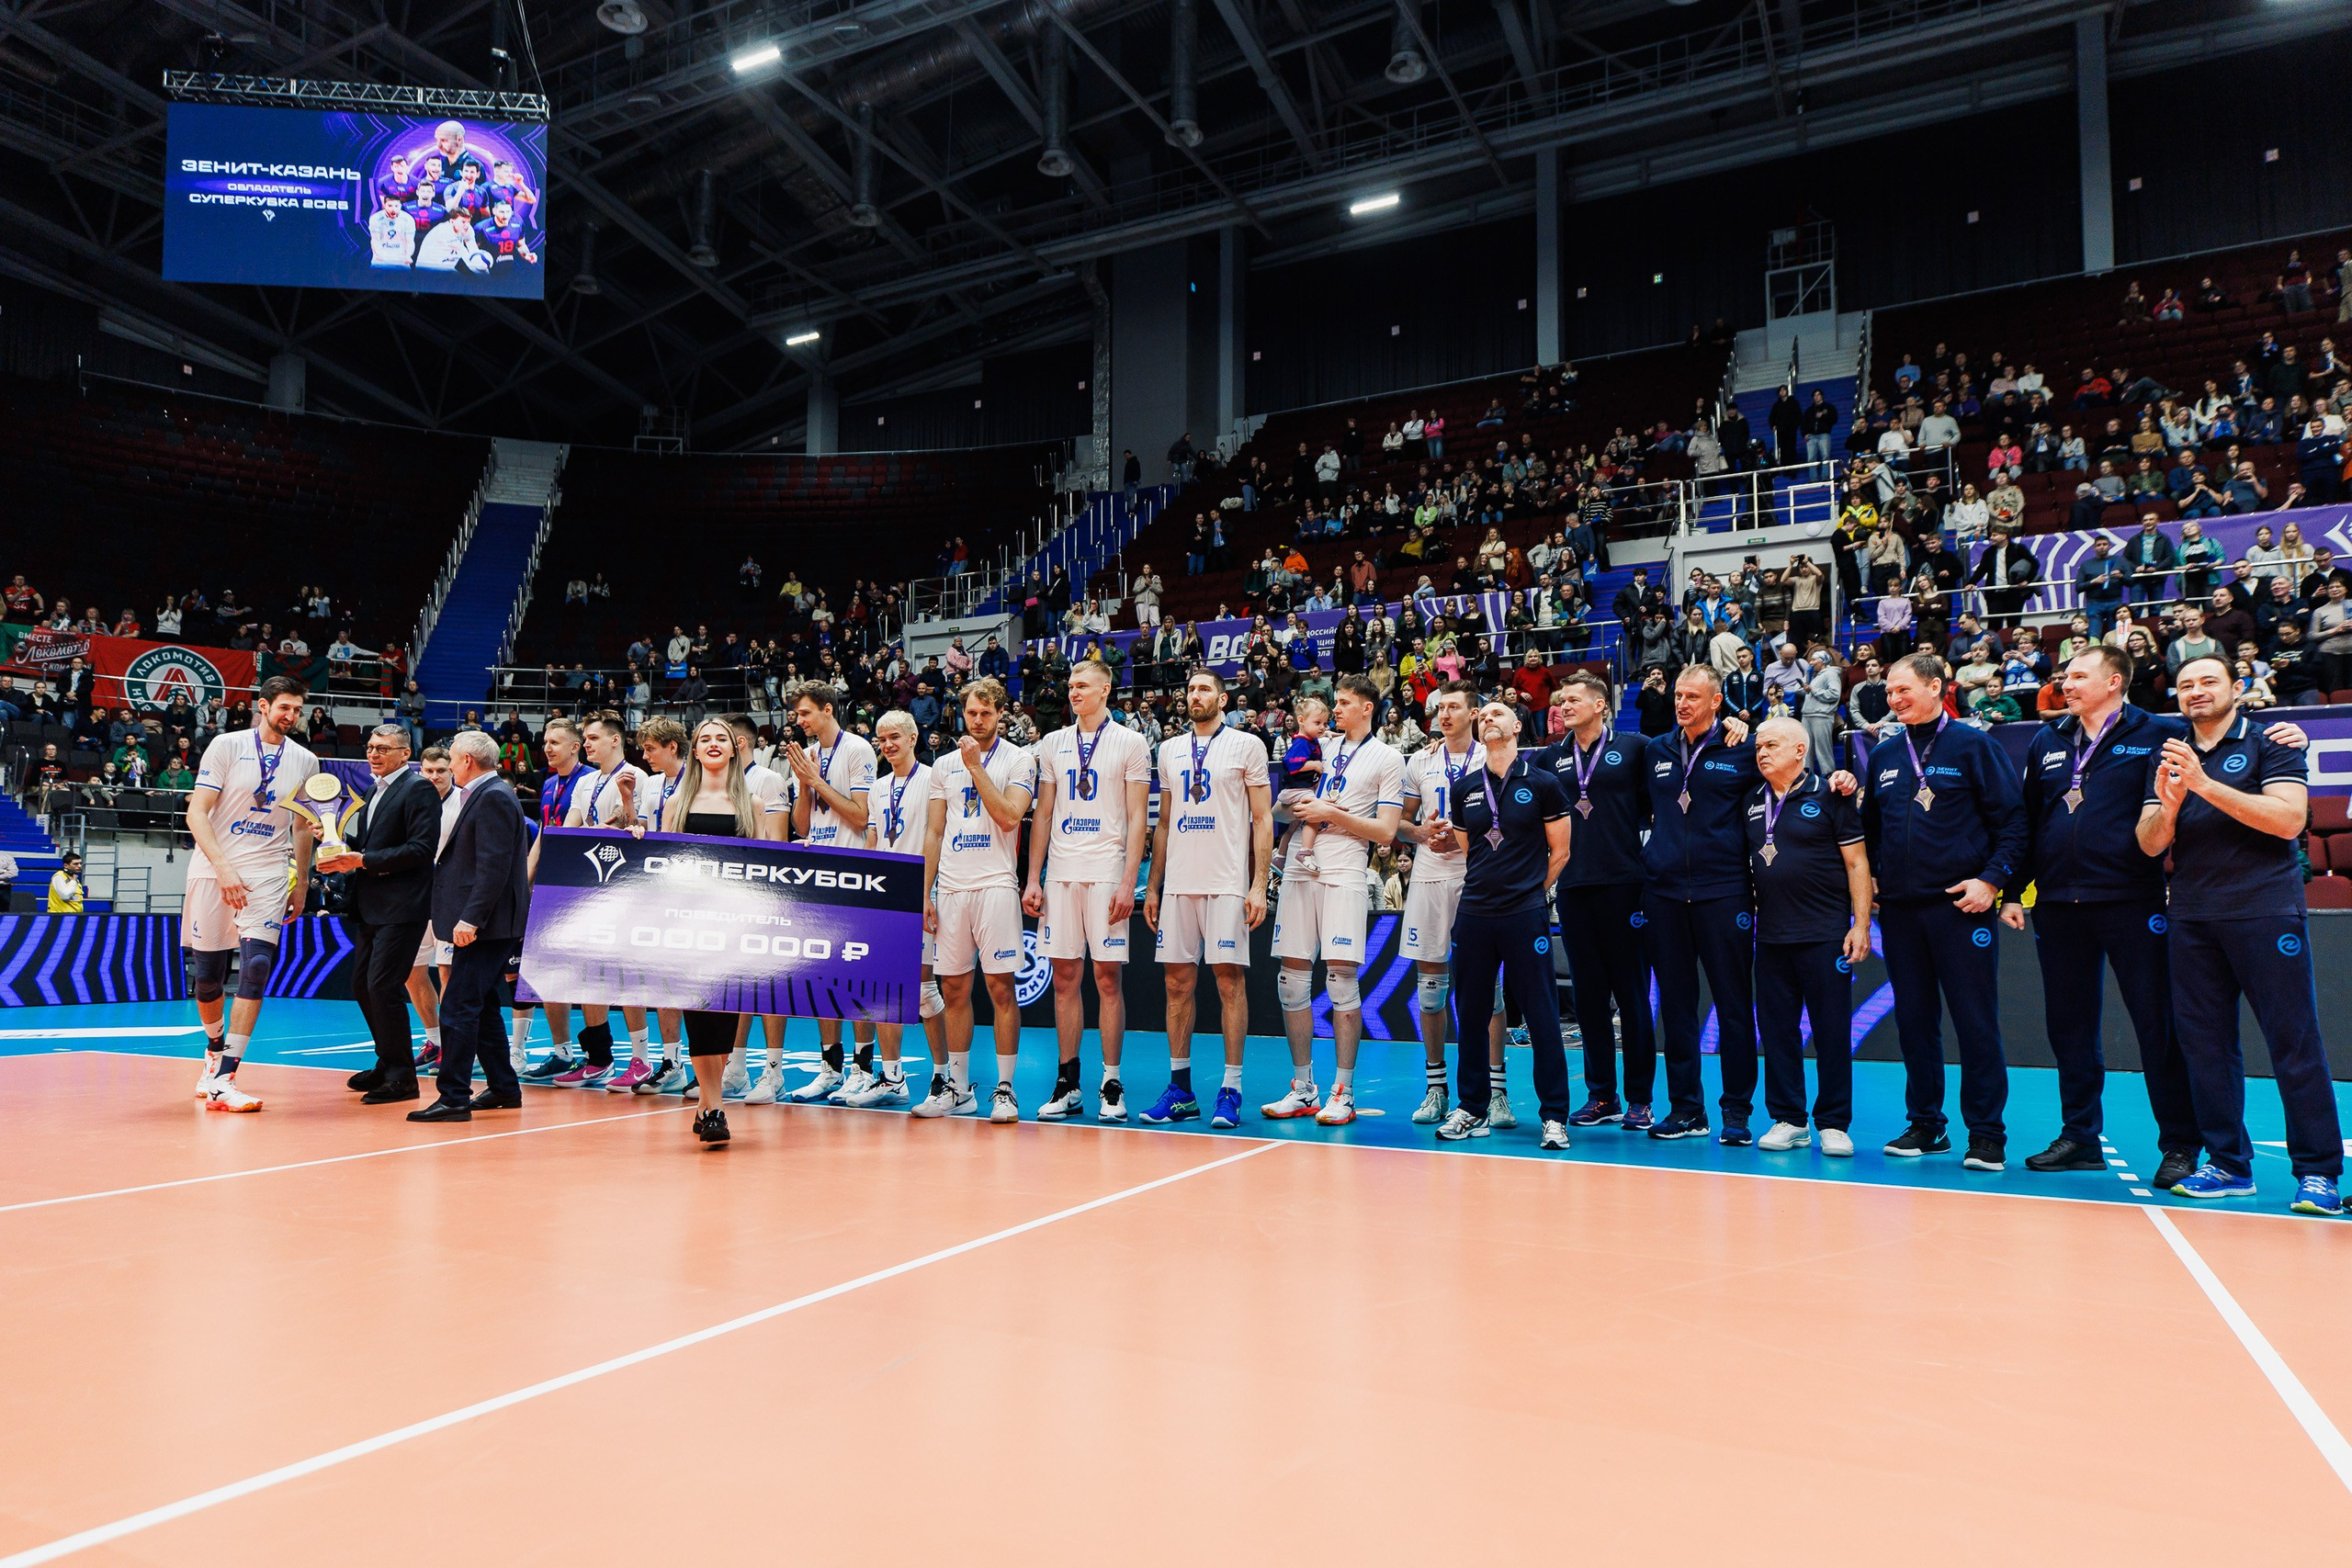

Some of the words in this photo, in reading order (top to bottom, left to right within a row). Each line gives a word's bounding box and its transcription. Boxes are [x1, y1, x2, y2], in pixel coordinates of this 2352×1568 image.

[181, 159, 362, 180] ЗЕНИТ-КАЗАНЬ
[228, 183, 312, 195] ОБЛАДАТЕЛЬ
[189, 193, 300, 209] СУПЕРКУБКА
[302, 198, 349, 210] 2025
[18, 632, 52, 643] ВМЕСТЕ
[136, 651, 216, 682] ЛОКОМОТИВ
[1066, 769, 1098, 801] 10
[246, 821, 276, 832] ГАЗПРОМ
[1072, 818, 1101, 827] ГАЗПРОМ
[1188, 817, 1215, 825] ГАЗПРОМ
[963, 834, 990, 842] ГАЗПРОМ
[664, 908, 792, 927] ПОБЕДИТЕЛЬ
[588, 924, 616, 945] 5
[630, 926, 727, 951] 000
[740, 933, 831, 959] 000
[1408, 928, 1418, 942] 15
